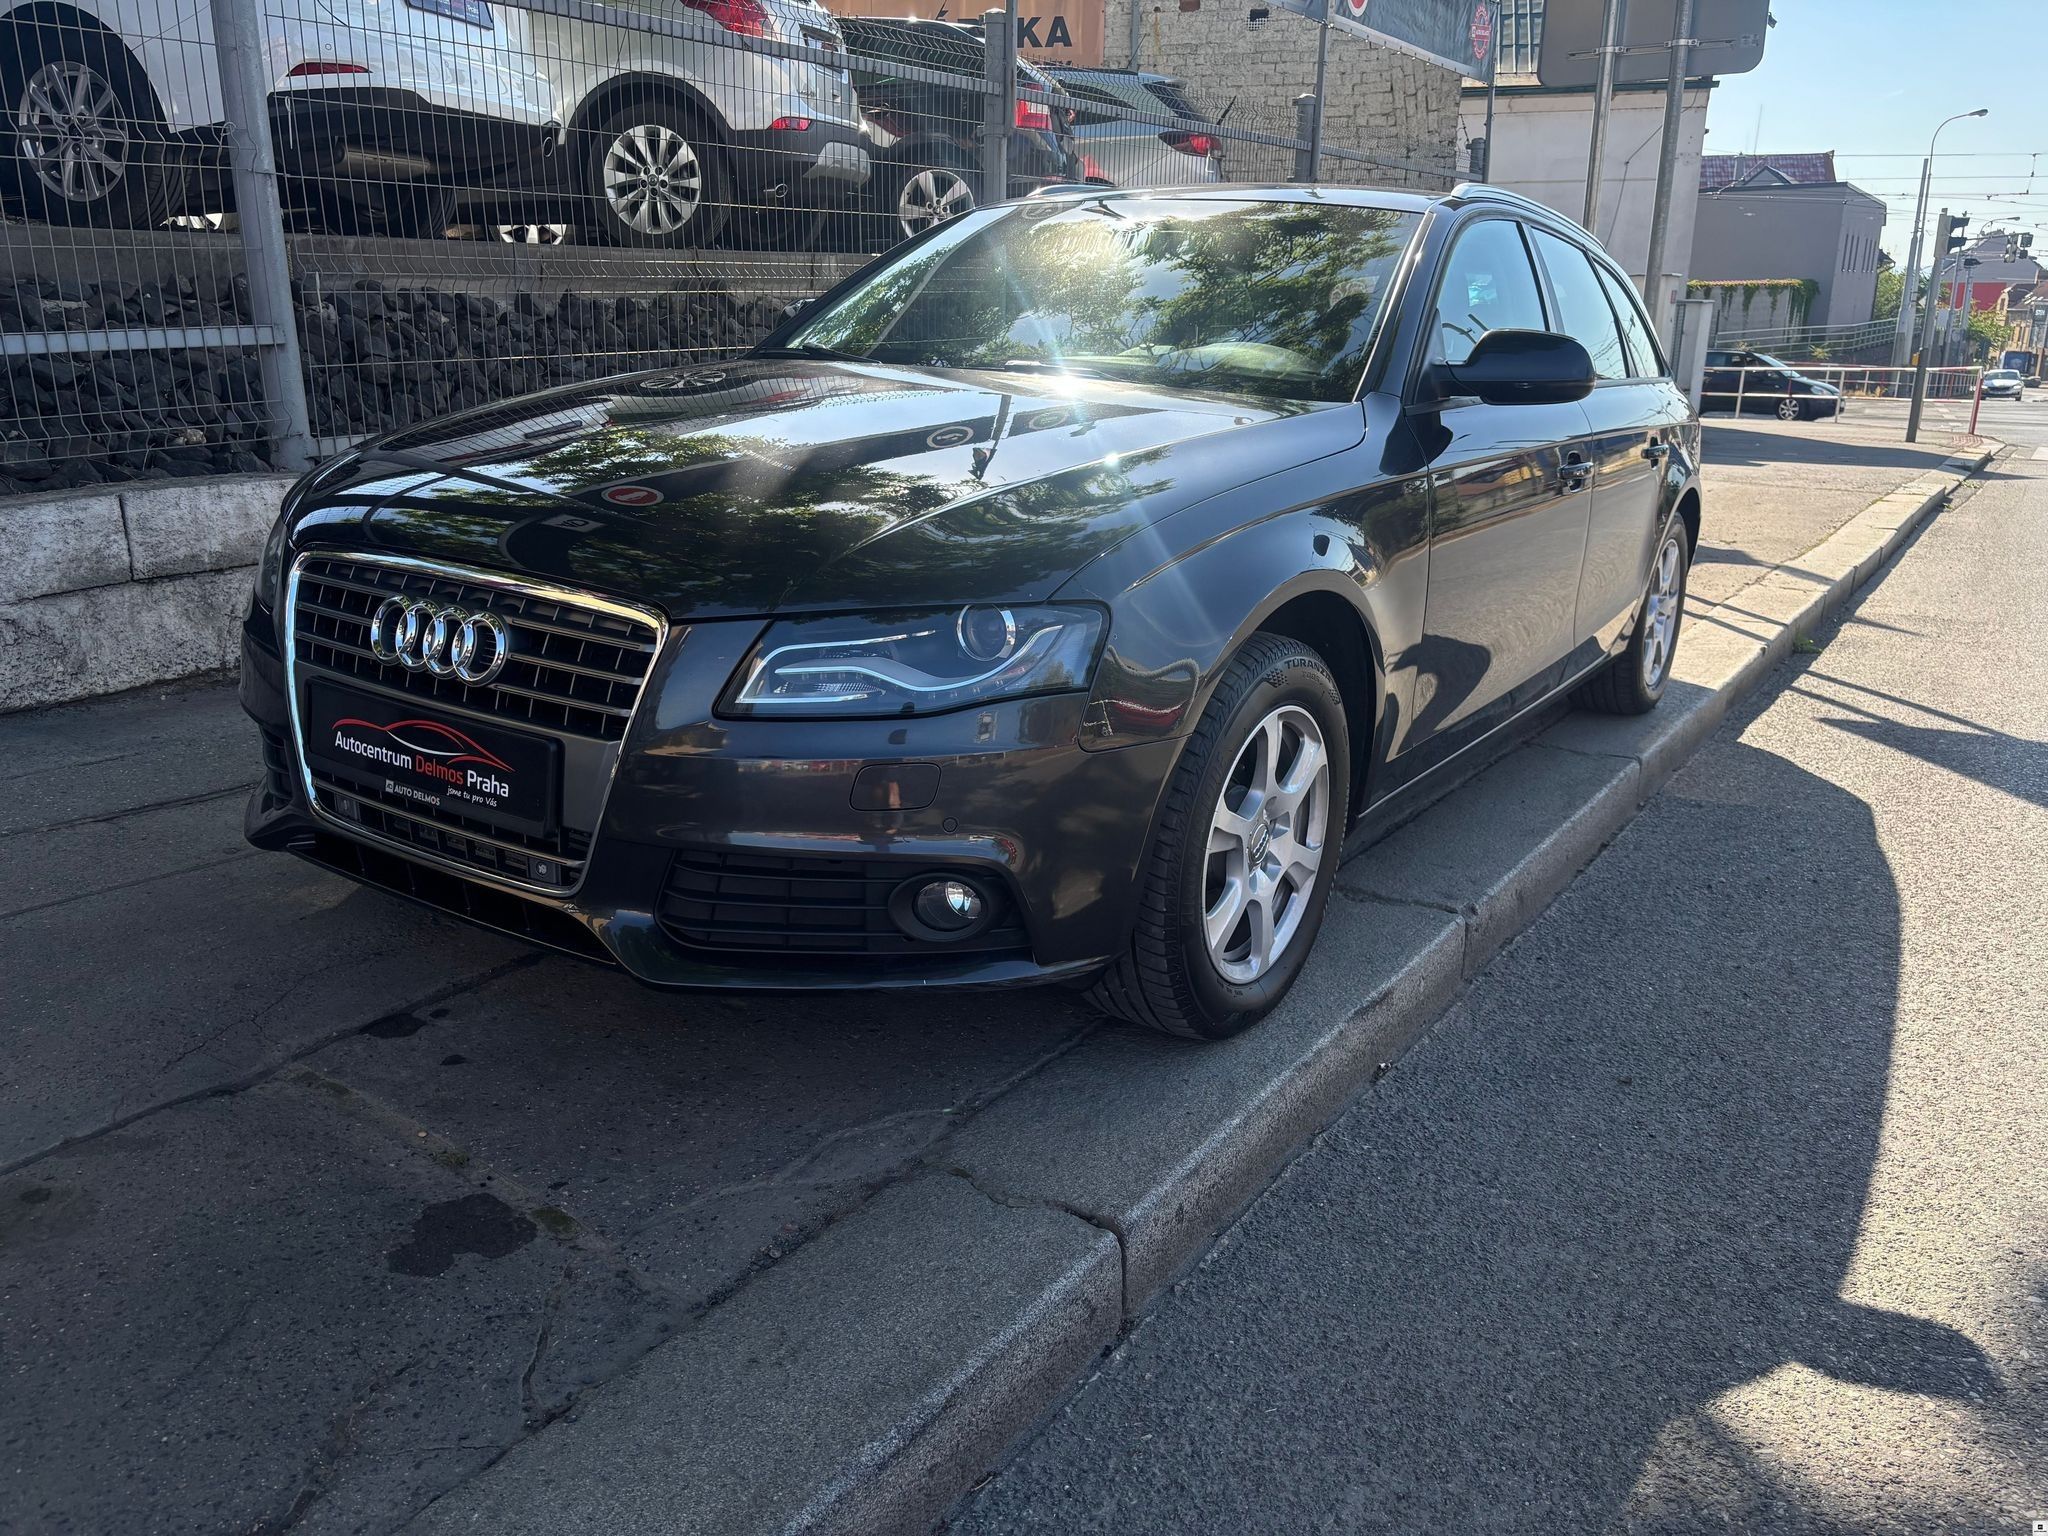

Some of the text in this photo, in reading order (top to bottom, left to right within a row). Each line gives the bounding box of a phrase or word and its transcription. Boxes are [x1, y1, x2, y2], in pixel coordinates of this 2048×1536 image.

[334, 730, 509, 798] Autocentrum Delmos Praha
[394, 784, 413, 797] AUTO
[413, 790, 441, 806] DELMOS
[446, 785, 498, 807] jsme tu pro Vás
